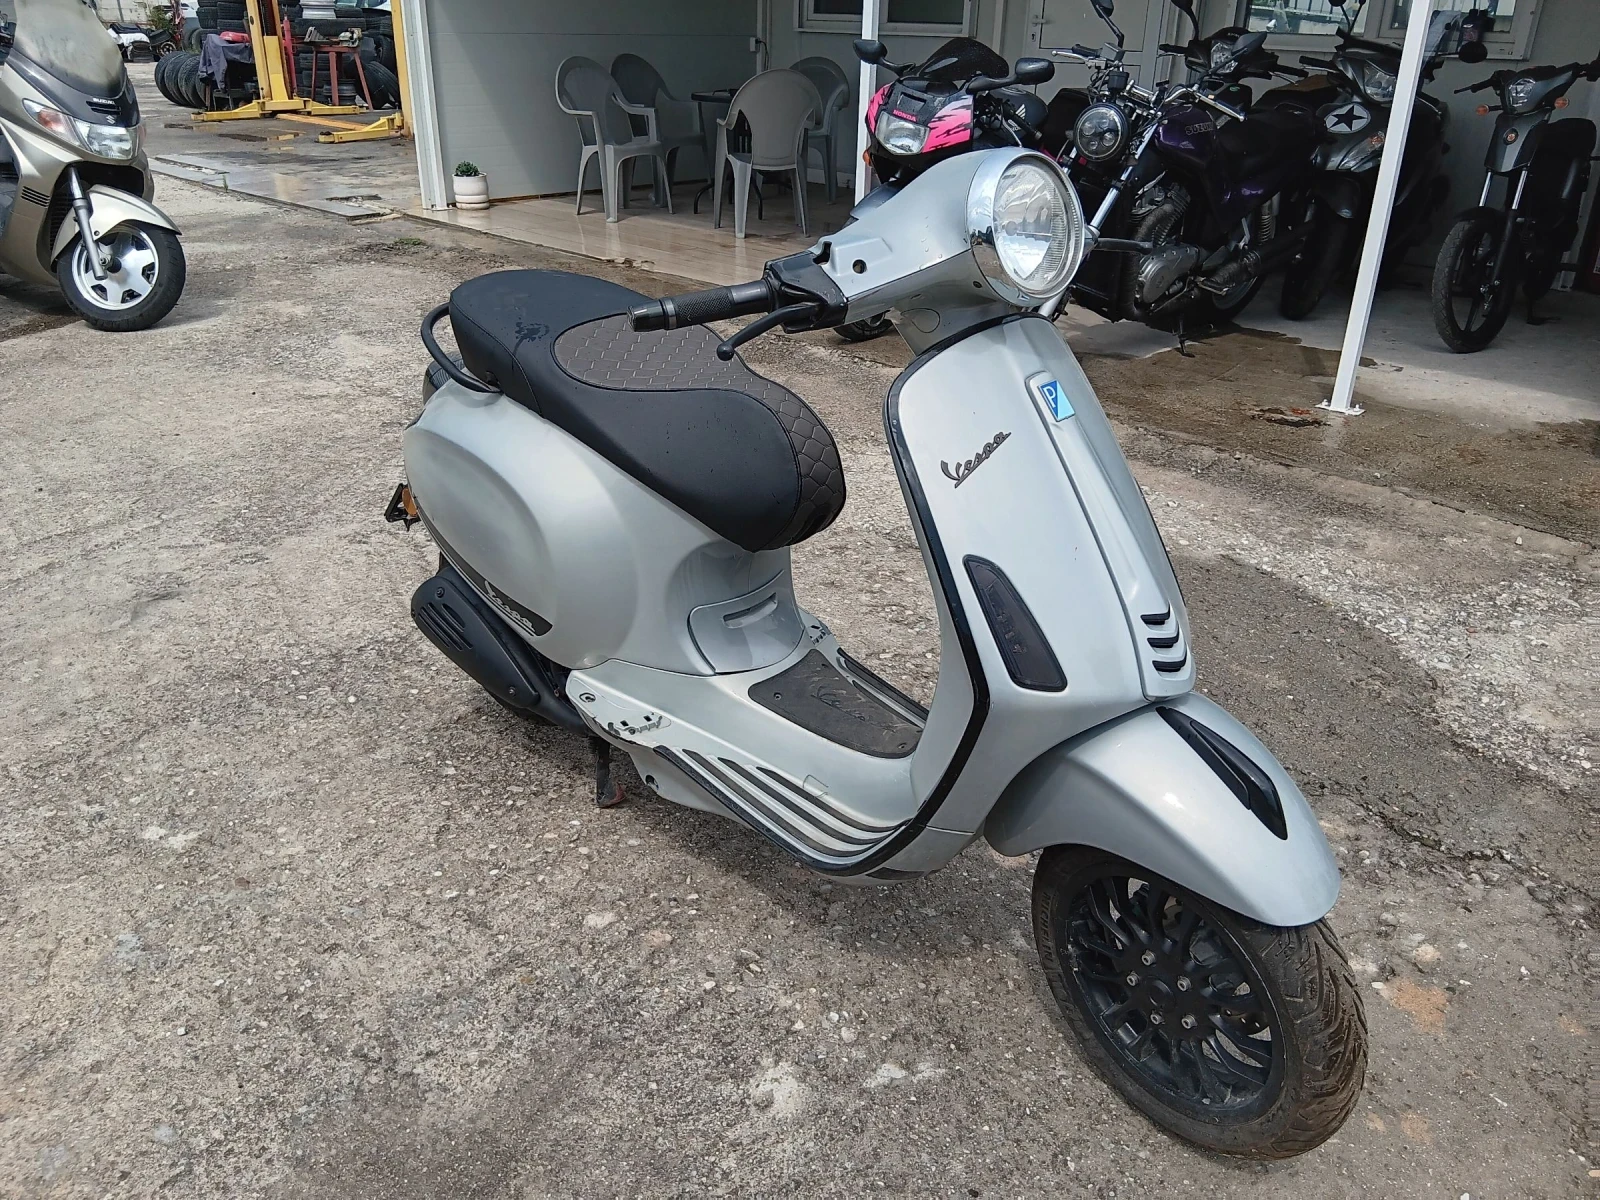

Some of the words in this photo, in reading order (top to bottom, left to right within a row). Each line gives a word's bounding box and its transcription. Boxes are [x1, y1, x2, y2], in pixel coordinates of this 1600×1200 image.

[892, 109, 917, 122] HONDA
[940, 431, 1012, 488] Vespa
[484, 580, 536, 632] Vespa
[1040, 891, 1054, 963] MICHELIN
